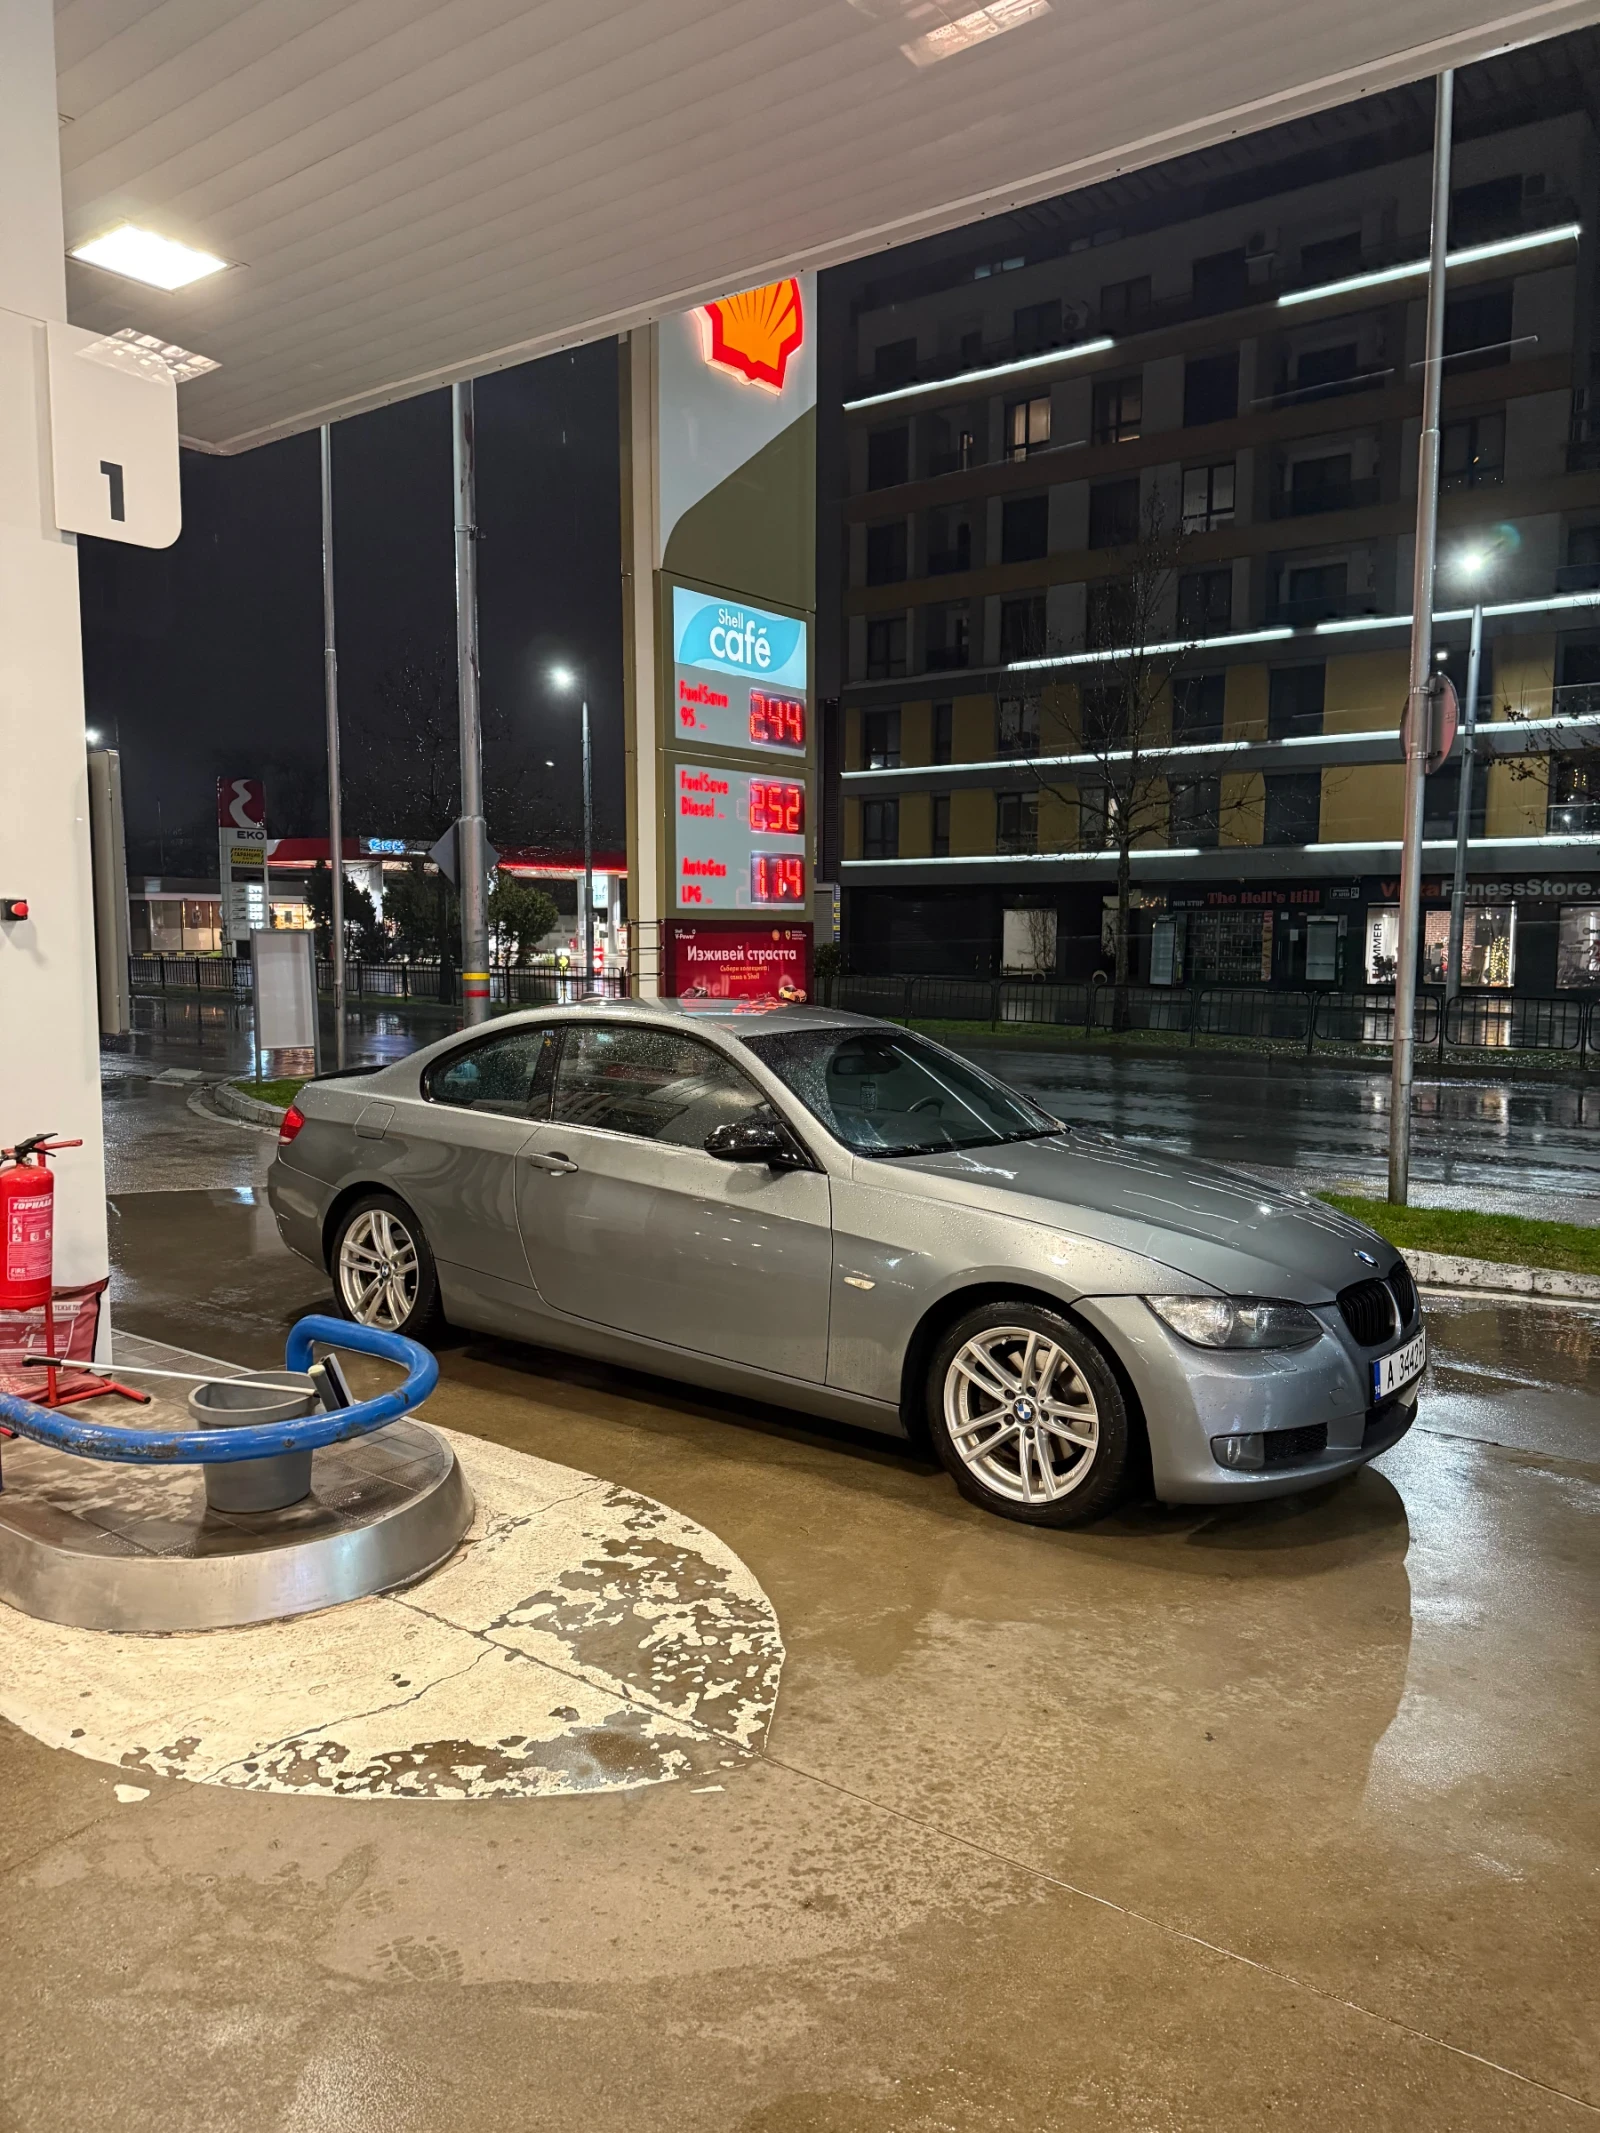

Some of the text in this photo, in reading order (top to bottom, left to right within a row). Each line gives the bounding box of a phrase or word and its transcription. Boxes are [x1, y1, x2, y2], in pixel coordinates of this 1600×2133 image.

[100, 459, 125, 522] 1
[718, 608, 744, 630] Shell
[709, 620, 771, 668] café
[679, 680, 729, 708] FuelSave
[680, 705, 696, 727] 95
[680, 770, 729, 794] FuelSave
[680, 796, 715, 818] Diesel
[237, 830, 265, 840] EKO
[682, 857, 727, 878] AutoGas
[681, 884, 702, 903] LPG
[1207, 891, 1236, 905] The
[1289, 889, 1321, 903] Hill
[687, 945, 797, 964] Изживей страстта
[1371, 923, 1382, 979] HAMMER
[1387, 1360, 1394, 1390] A
